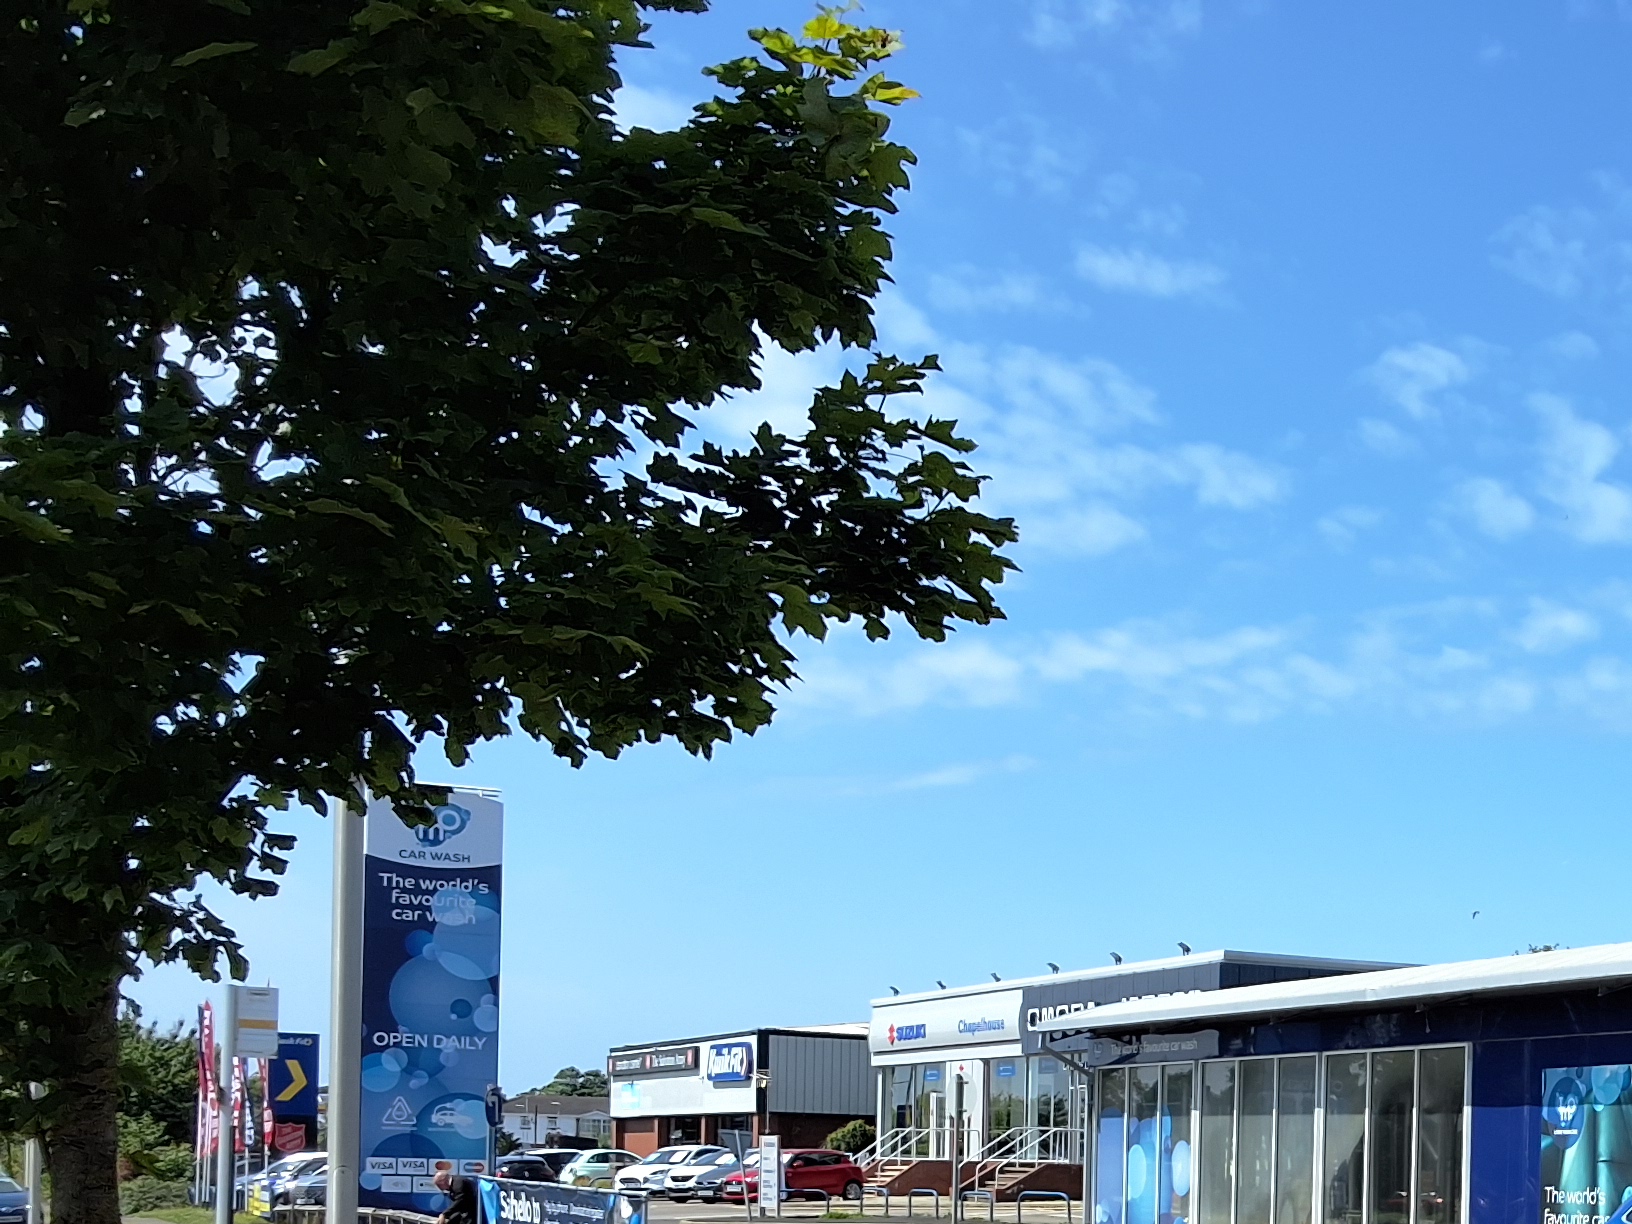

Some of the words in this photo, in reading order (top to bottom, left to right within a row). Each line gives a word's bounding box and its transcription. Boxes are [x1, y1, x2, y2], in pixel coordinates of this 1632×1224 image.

[399, 849, 427, 860] CAR
[430, 852, 471, 863] WASH
[378, 872, 416, 889] The
[419, 877, 490, 895] world's
[391, 889, 477, 909] favourite
[391, 909, 422, 921] car
[896, 1023, 926, 1042] SUZUKI
[957, 1016, 1005, 1036] Chapelhouse
[372, 1031, 428, 1048] OPEN
[433, 1034, 488, 1050] DAILY
[370, 1161, 394, 1170] VISA
[402, 1160, 425, 1169] VISA
[1544, 1186, 1565, 1204] The
[1567, 1186, 1606, 1205] world's
